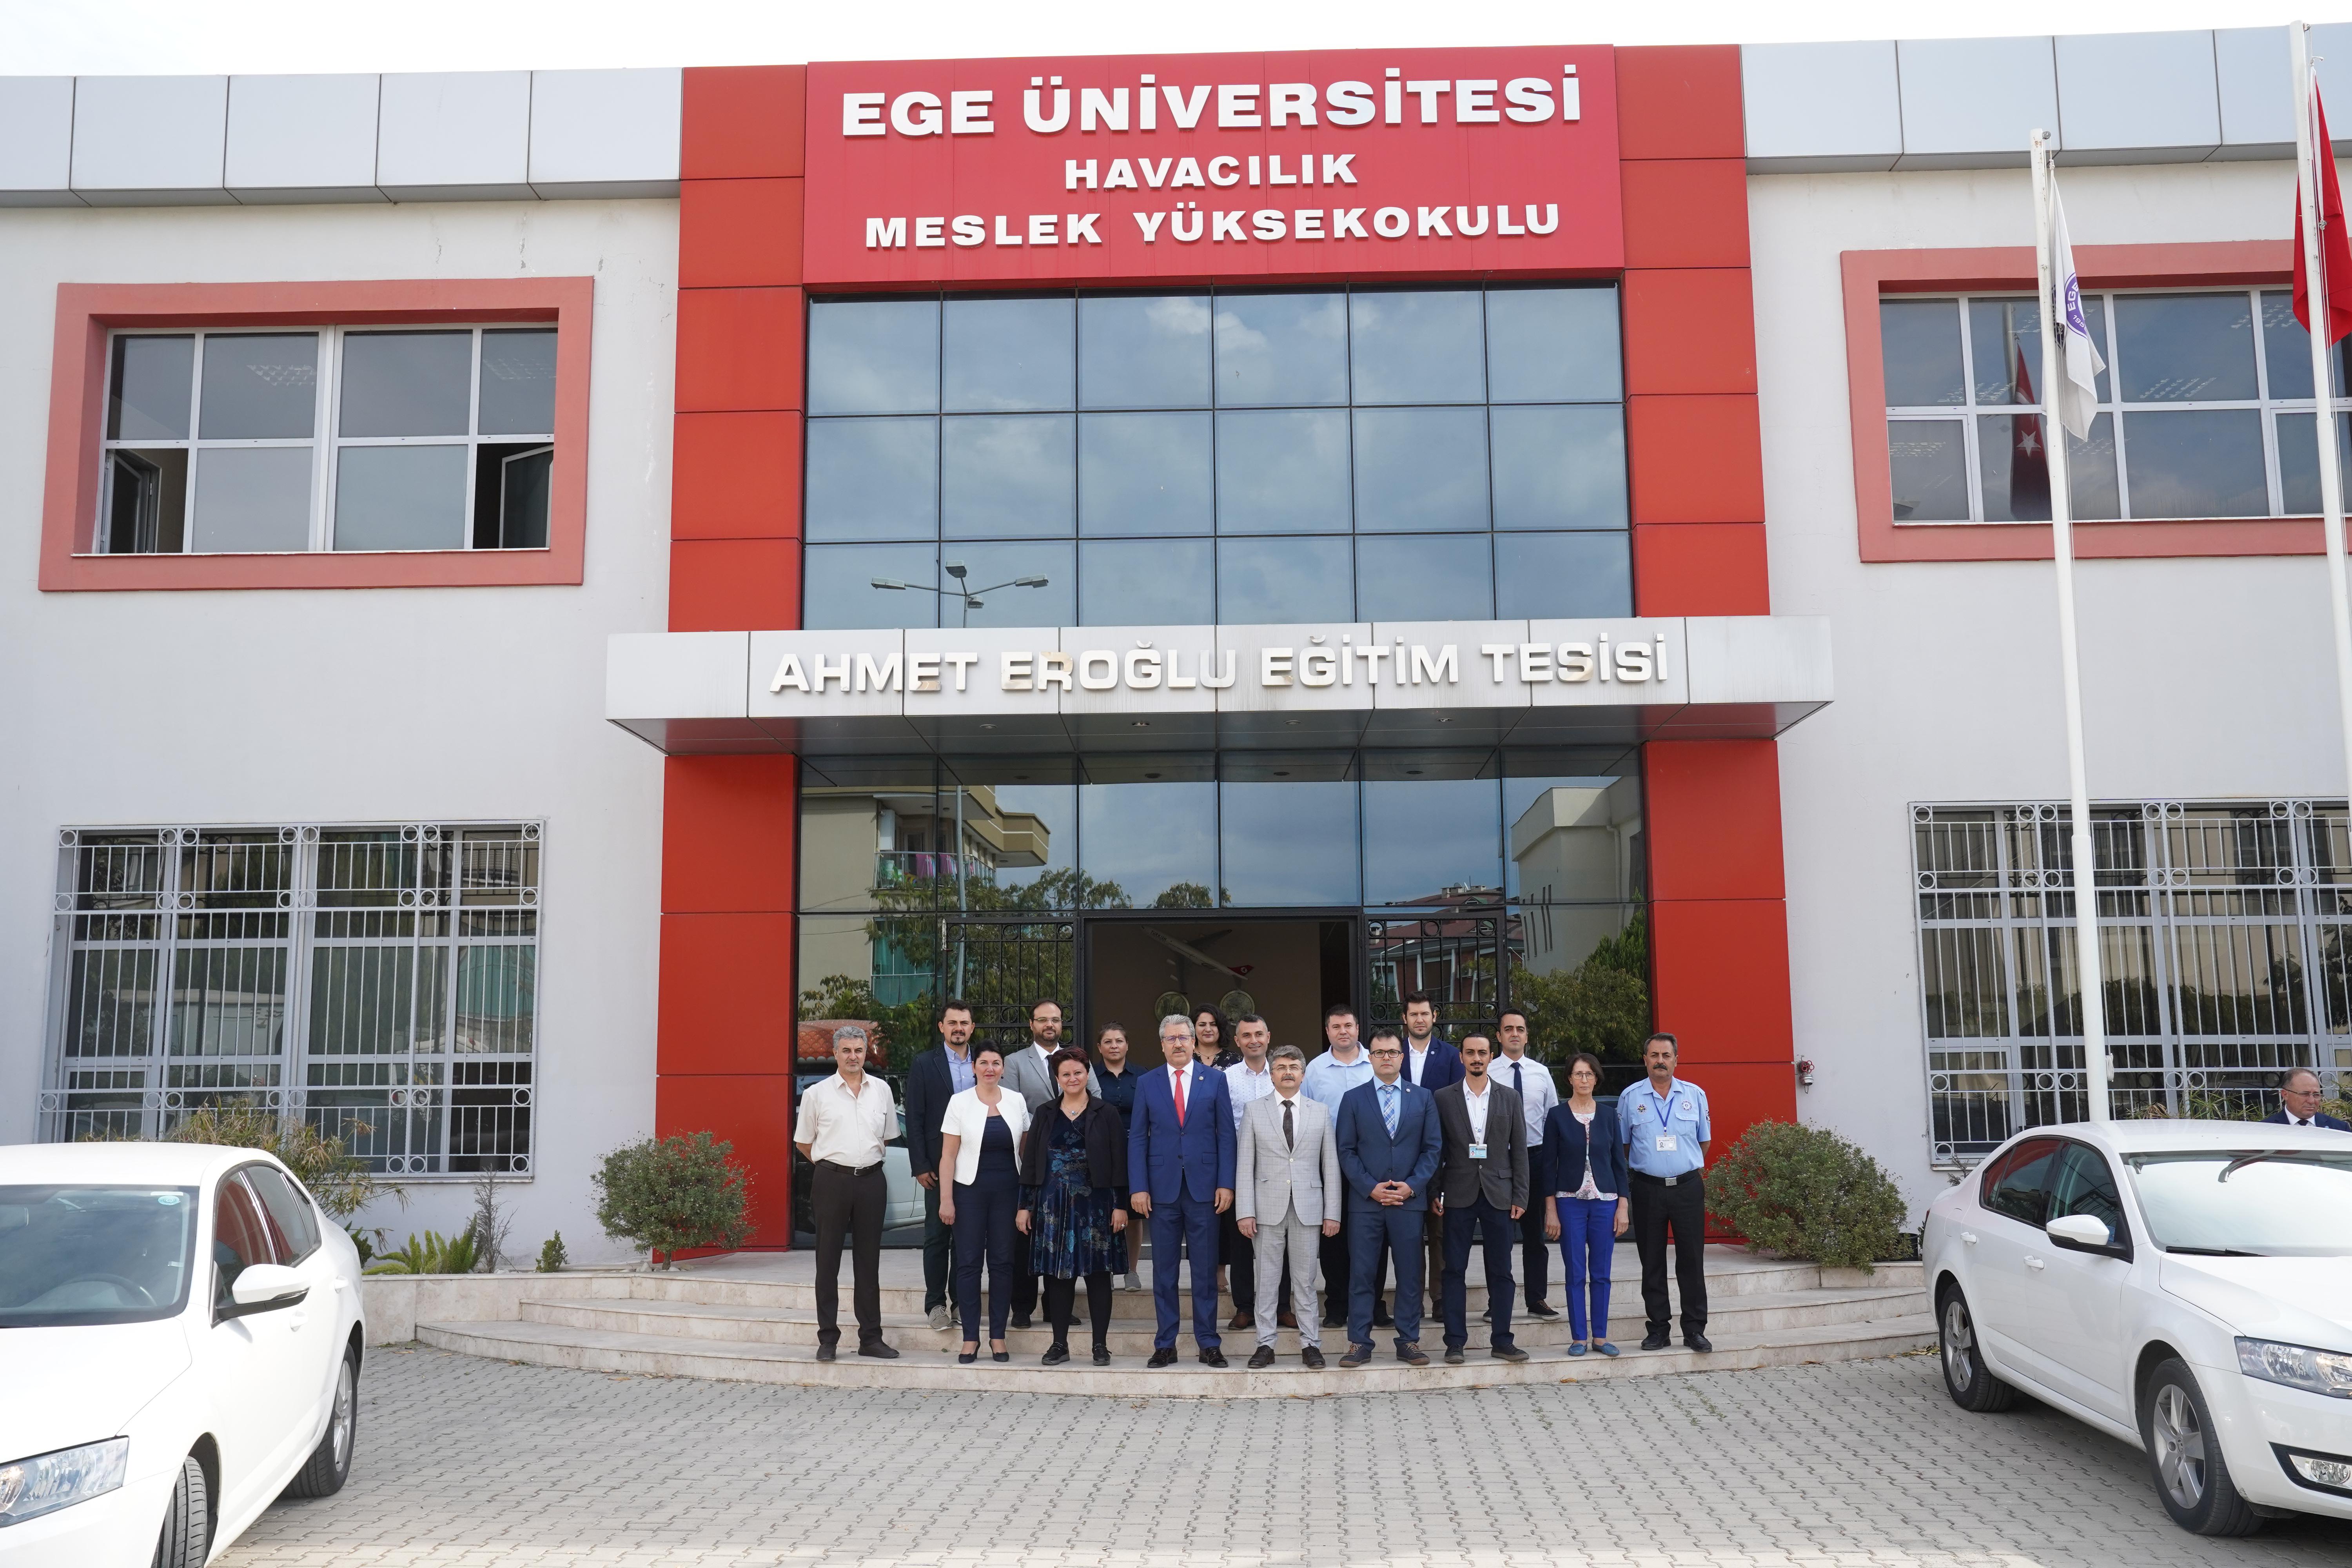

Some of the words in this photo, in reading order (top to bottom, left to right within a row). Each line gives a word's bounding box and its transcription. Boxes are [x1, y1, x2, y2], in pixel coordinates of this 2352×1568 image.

[842, 90, 994, 136] EGE
[1024, 64, 1580, 132] ÜNİVERSİTESİ
[1065, 154, 1358, 189] HAVACILIK
[866, 213, 1102, 247] MESLEK
[1133, 202, 1559, 242] YÜKSEKOKULU
[2067, 281, 2079, 312] EGE
[2073, 314, 2087, 332] 195
[769, 652, 978, 692] AHMET
[1001, 640, 1236, 691] EROĞLU
[1261, 634, 1459, 686] EĞİTİM
[1481, 632, 1668, 682] TESİSİ
[1151, 930, 1167, 941] TURKISH
